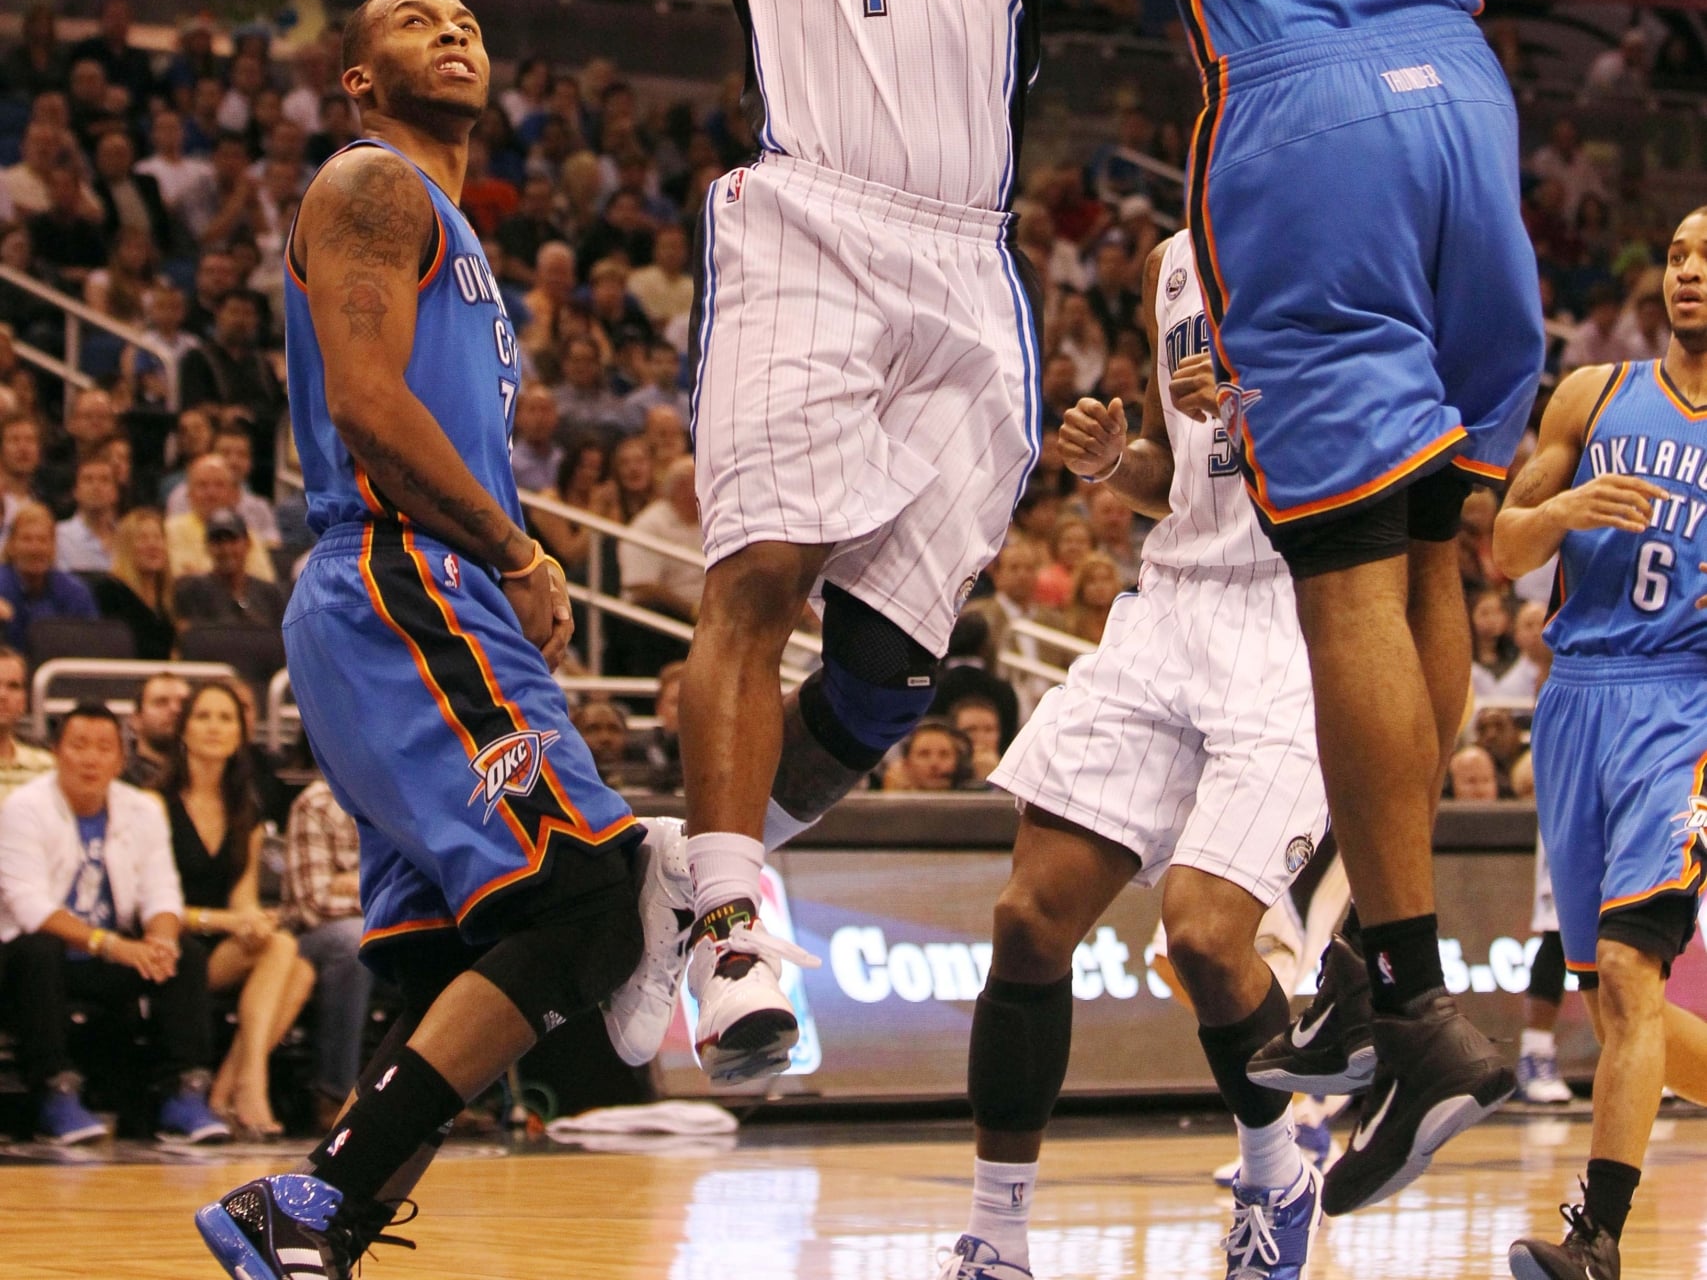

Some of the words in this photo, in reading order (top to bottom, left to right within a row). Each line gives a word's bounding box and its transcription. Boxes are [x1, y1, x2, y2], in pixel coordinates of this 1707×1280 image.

[1650, 493, 1707, 540] ITY
[1631, 540, 1678, 614] 6
[486, 740, 528, 802] OKC
